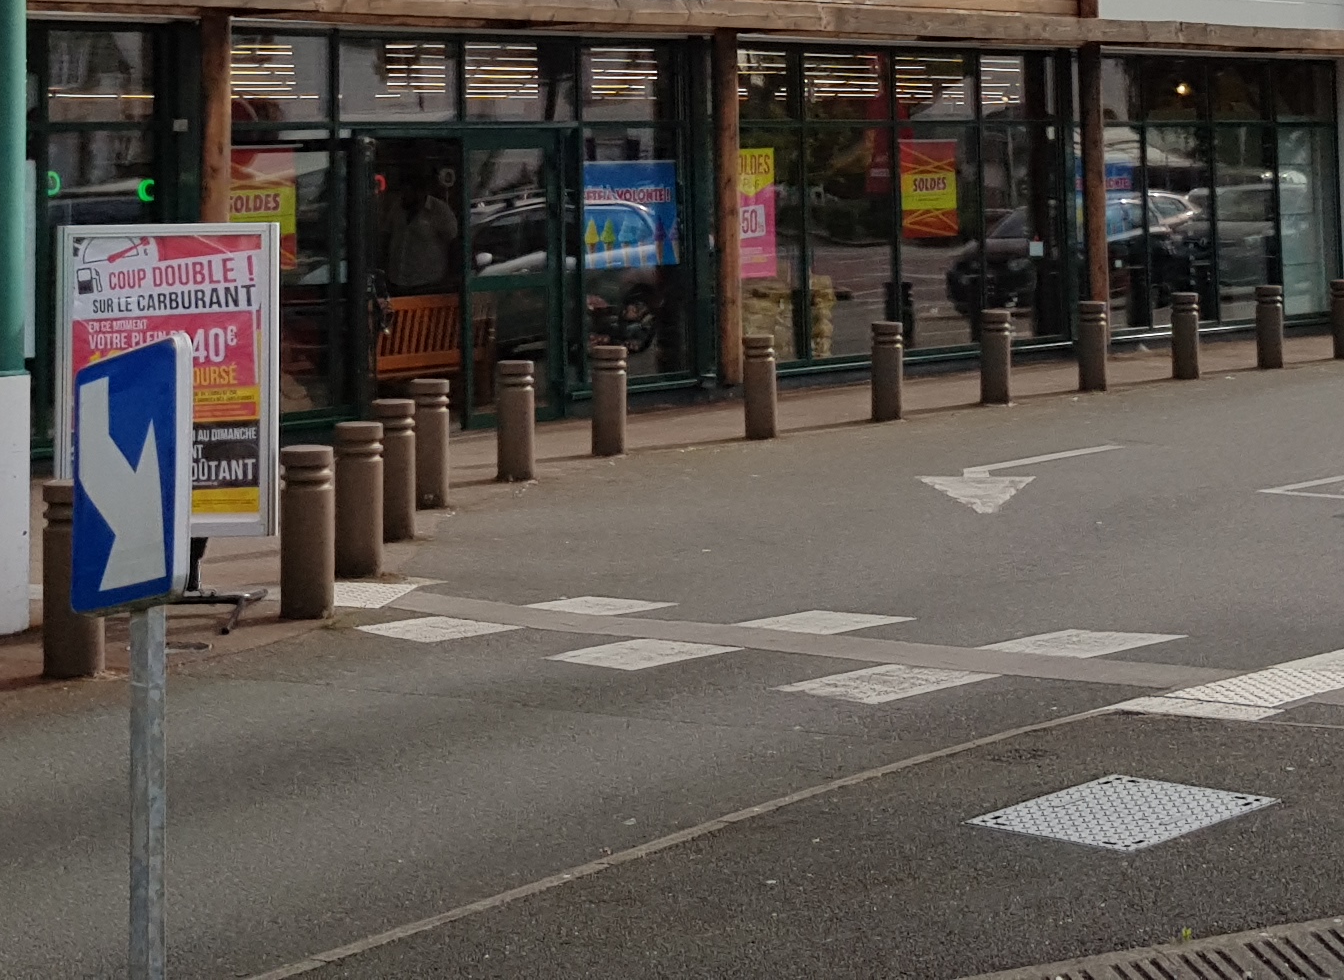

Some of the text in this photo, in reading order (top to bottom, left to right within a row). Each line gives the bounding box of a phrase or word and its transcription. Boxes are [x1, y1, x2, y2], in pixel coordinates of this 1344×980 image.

[912, 177, 947, 192] SOLDES
[109, 268, 147, 291] COUP
[152, 257, 237, 288] DOUBLE
[92, 284, 257, 314] SUR LE CARBURANT
[88, 322, 100, 333] EN
[112, 320, 148, 331] MOMENT
[88, 332, 129, 350] VOTRE
[197, 429, 210, 442] AU
[211, 427, 257, 441] DIMANCHE
